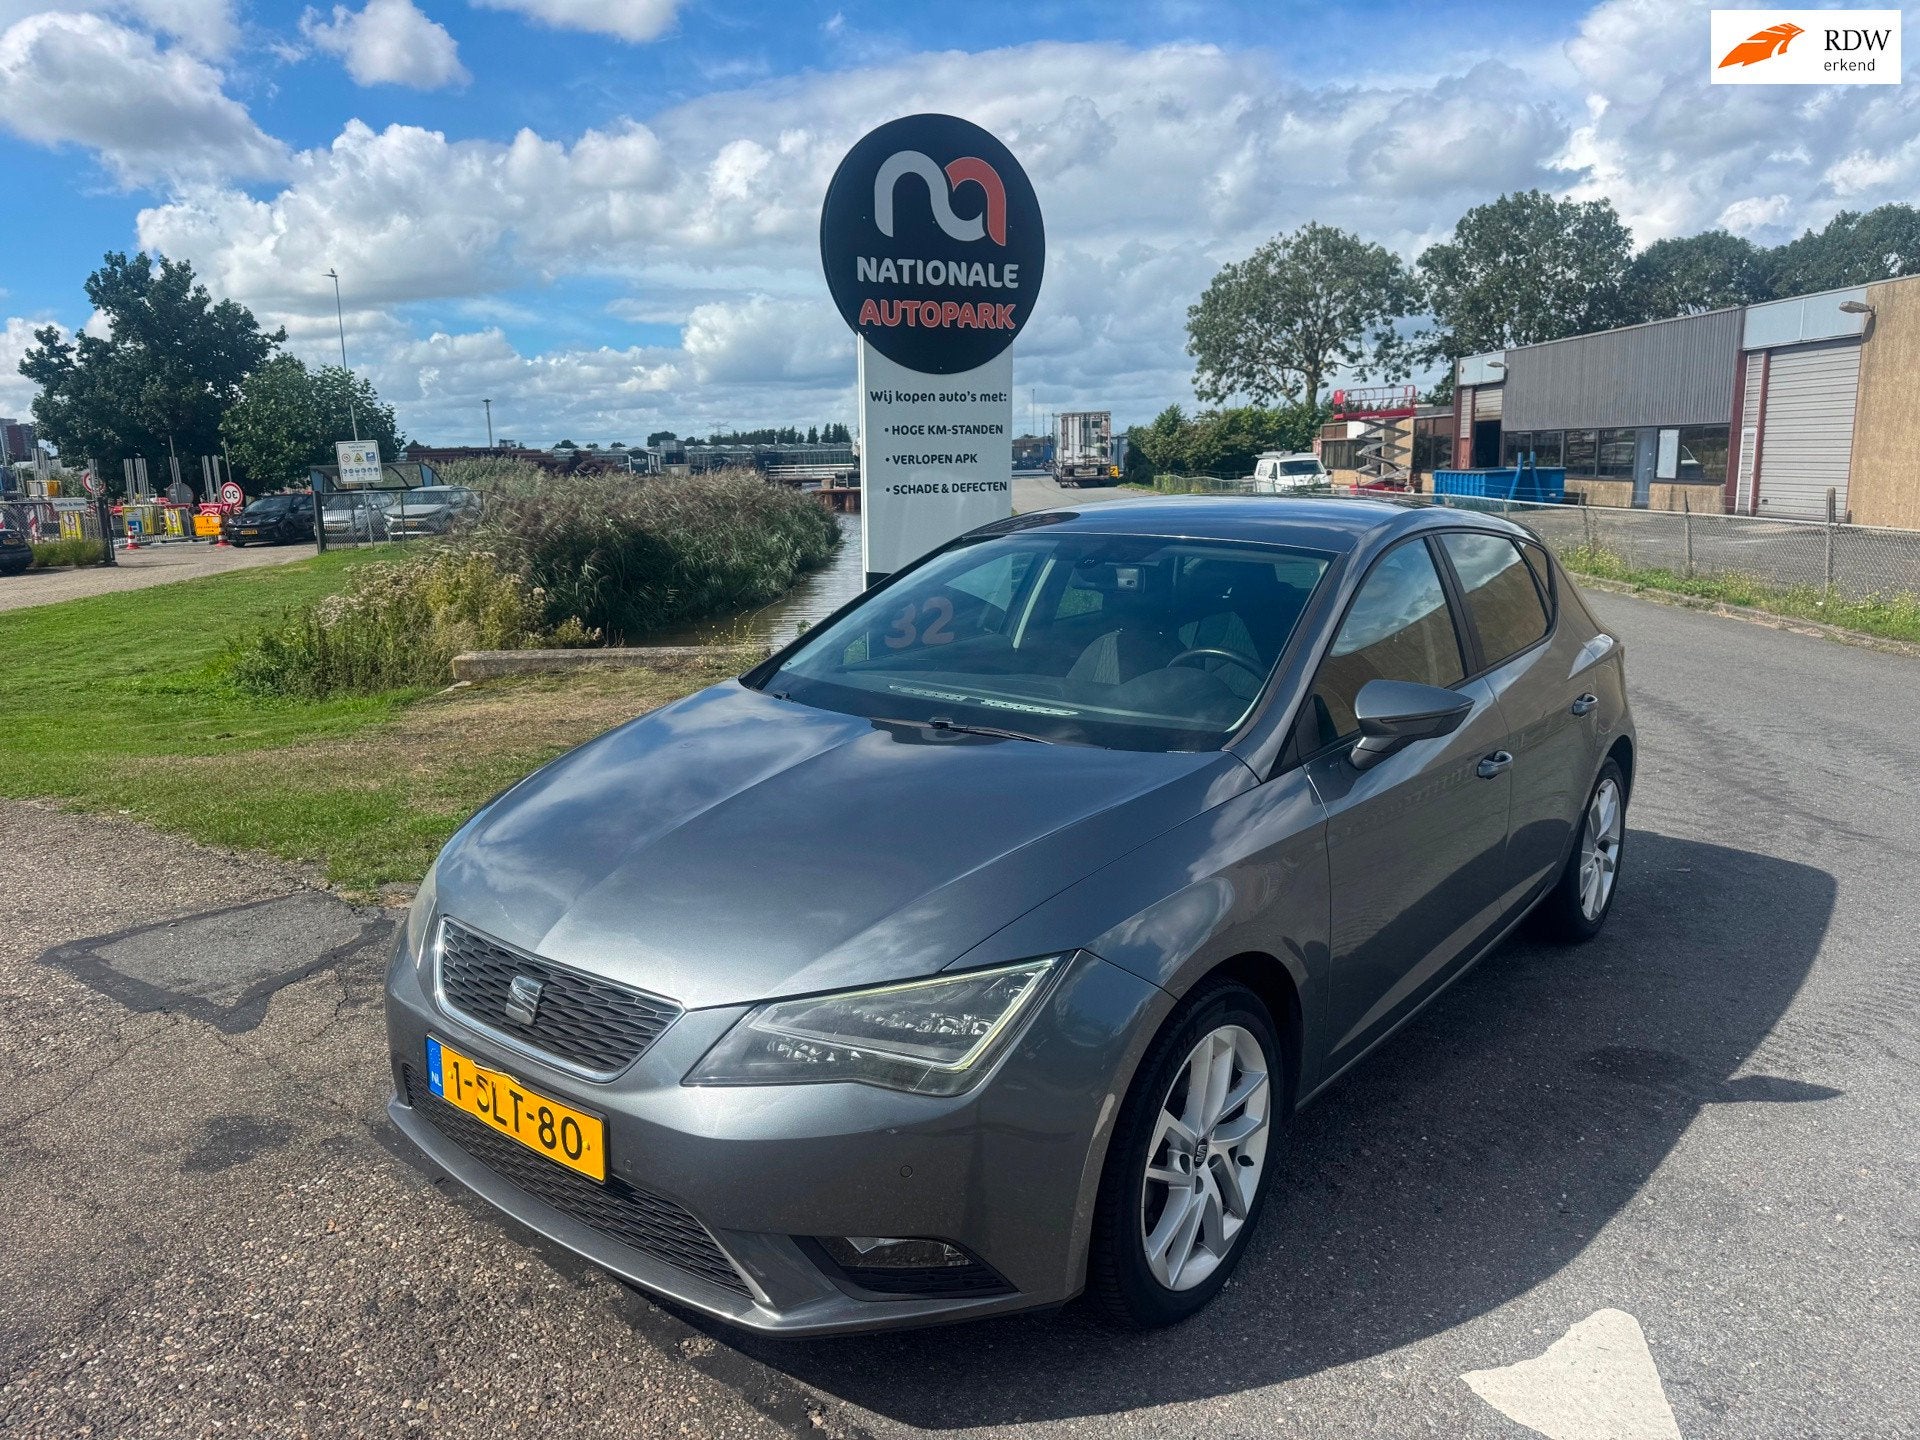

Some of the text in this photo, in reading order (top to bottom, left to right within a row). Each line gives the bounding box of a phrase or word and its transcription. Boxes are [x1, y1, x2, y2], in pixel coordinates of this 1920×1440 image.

[856, 256, 1019, 289] NATIONALE
[858, 298, 1017, 330] AUTOPARK
[870, 390, 1008, 405] Wij kopen auto's met:
[891, 424, 1004, 435] HOGE KM-STANDEN
[892, 453, 978, 465] VERLOPEN APK
[893, 481, 1008, 495] SCHADE & DEFECTEN
[884, 596, 955, 649] 32
[431, 1070, 442, 1087] NL
[452, 1061, 583, 1161] 1-SLT-80
